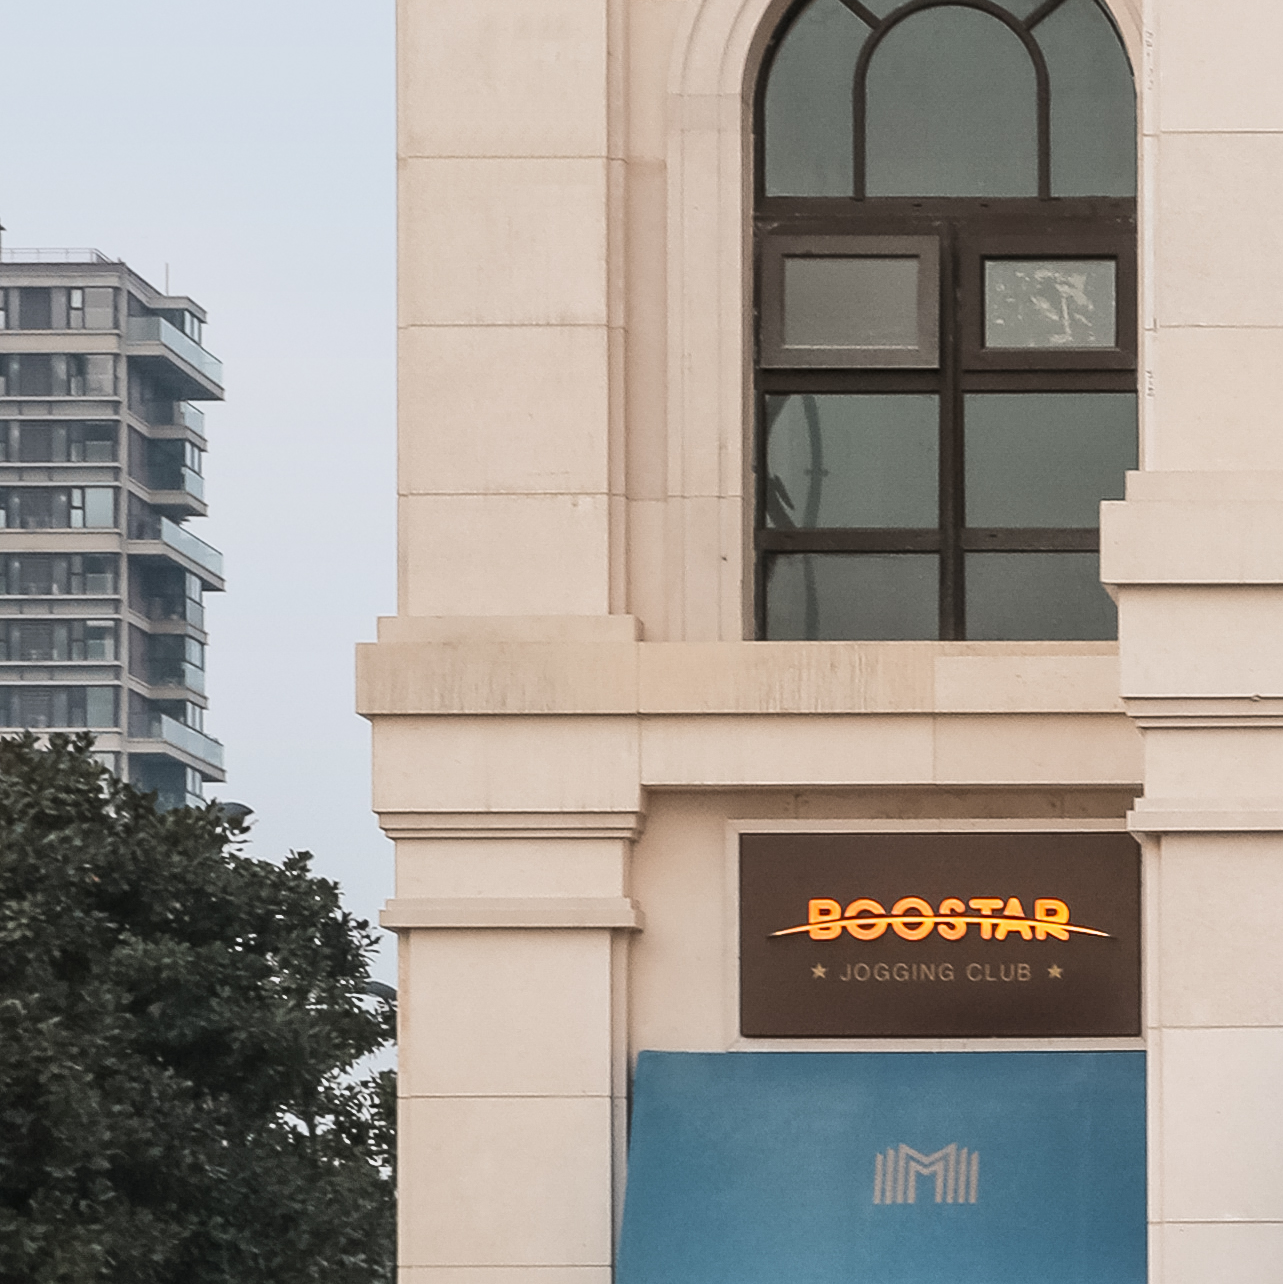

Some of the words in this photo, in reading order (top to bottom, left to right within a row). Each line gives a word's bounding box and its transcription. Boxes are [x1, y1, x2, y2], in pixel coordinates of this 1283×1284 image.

[807, 896, 1071, 942] BOOSTAR
[840, 963, 955, 983] JOGGING
[966, 963, 1032, 982] CLUB
